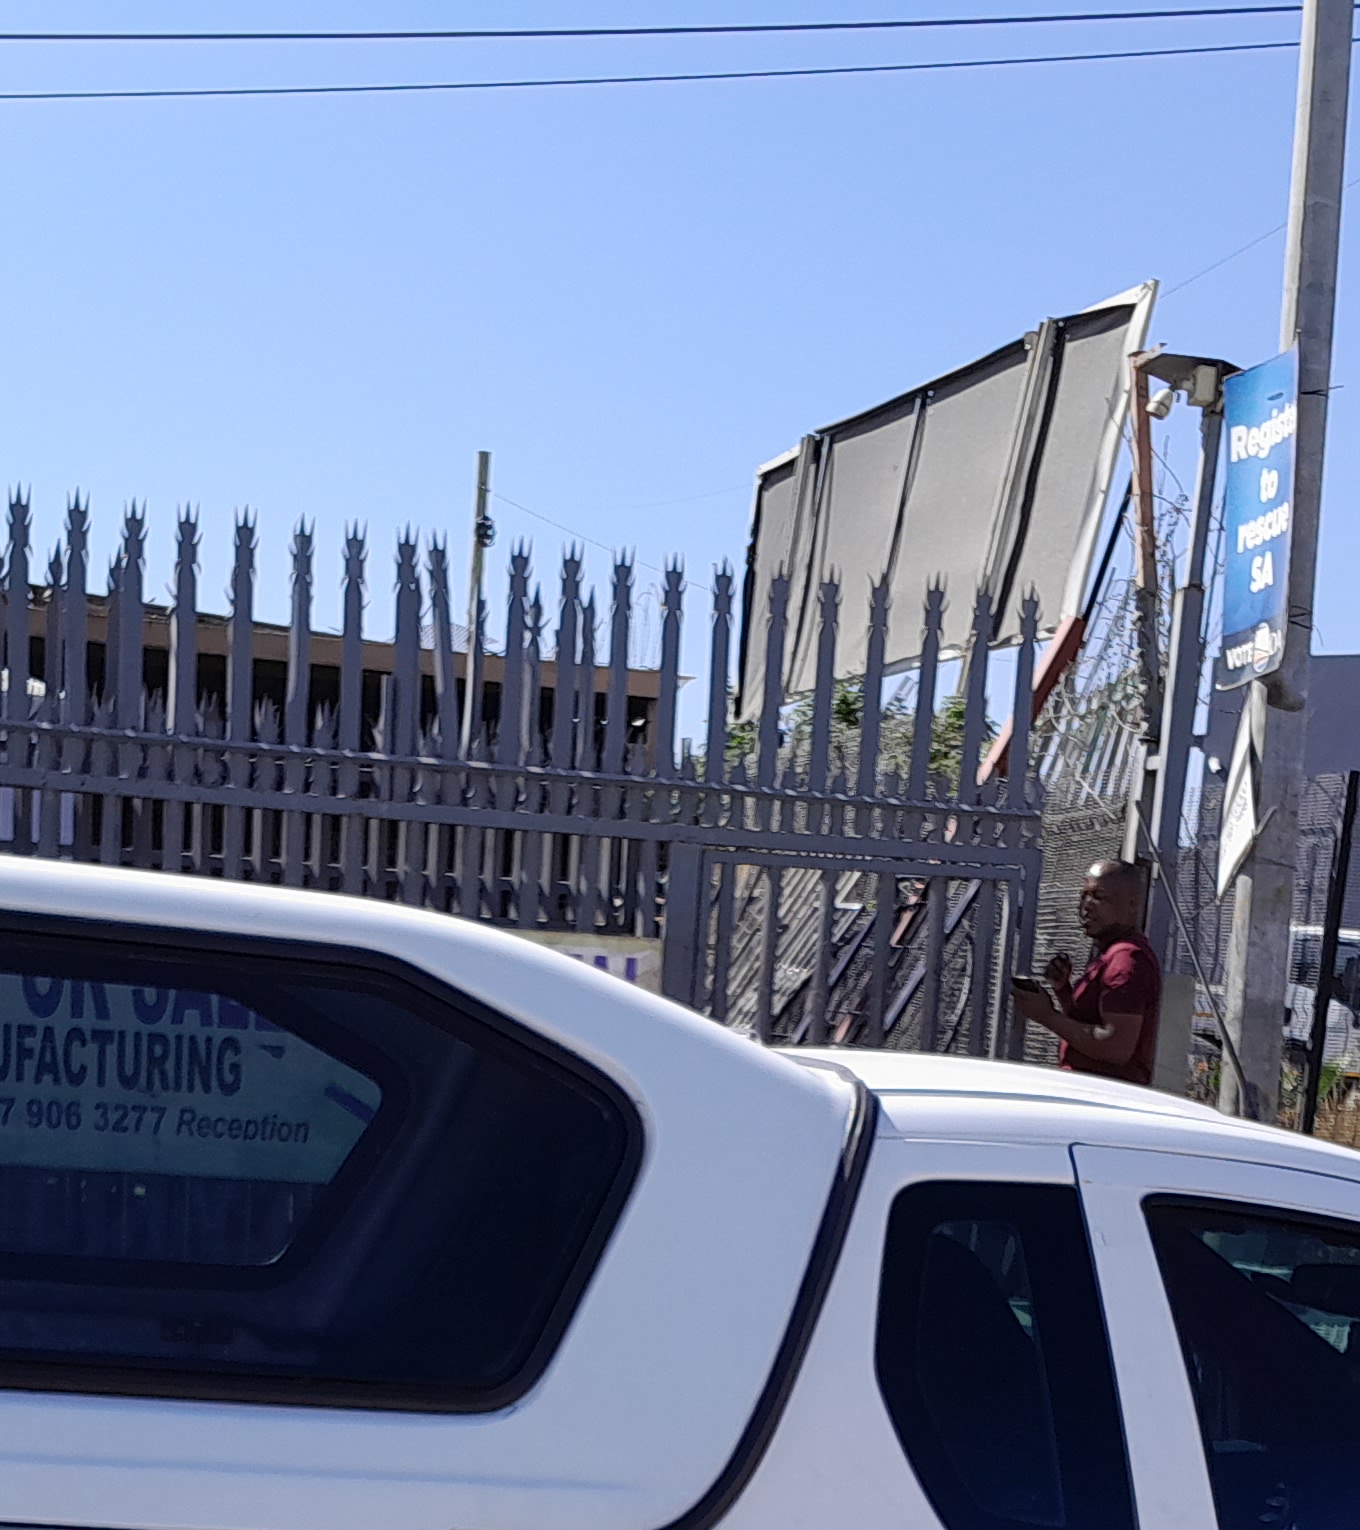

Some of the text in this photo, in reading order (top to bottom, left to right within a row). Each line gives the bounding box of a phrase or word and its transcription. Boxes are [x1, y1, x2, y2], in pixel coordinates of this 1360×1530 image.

[1260, 467, 1279, 503] to
[1237, 501, 1290, 554] rescue
[1249, 550, 1275, 593] SA
[26, 1098, 83, 1131] 906
[92, 1101, 169, 1136] 3277
[175, 1105, 311, 1144] Reception
